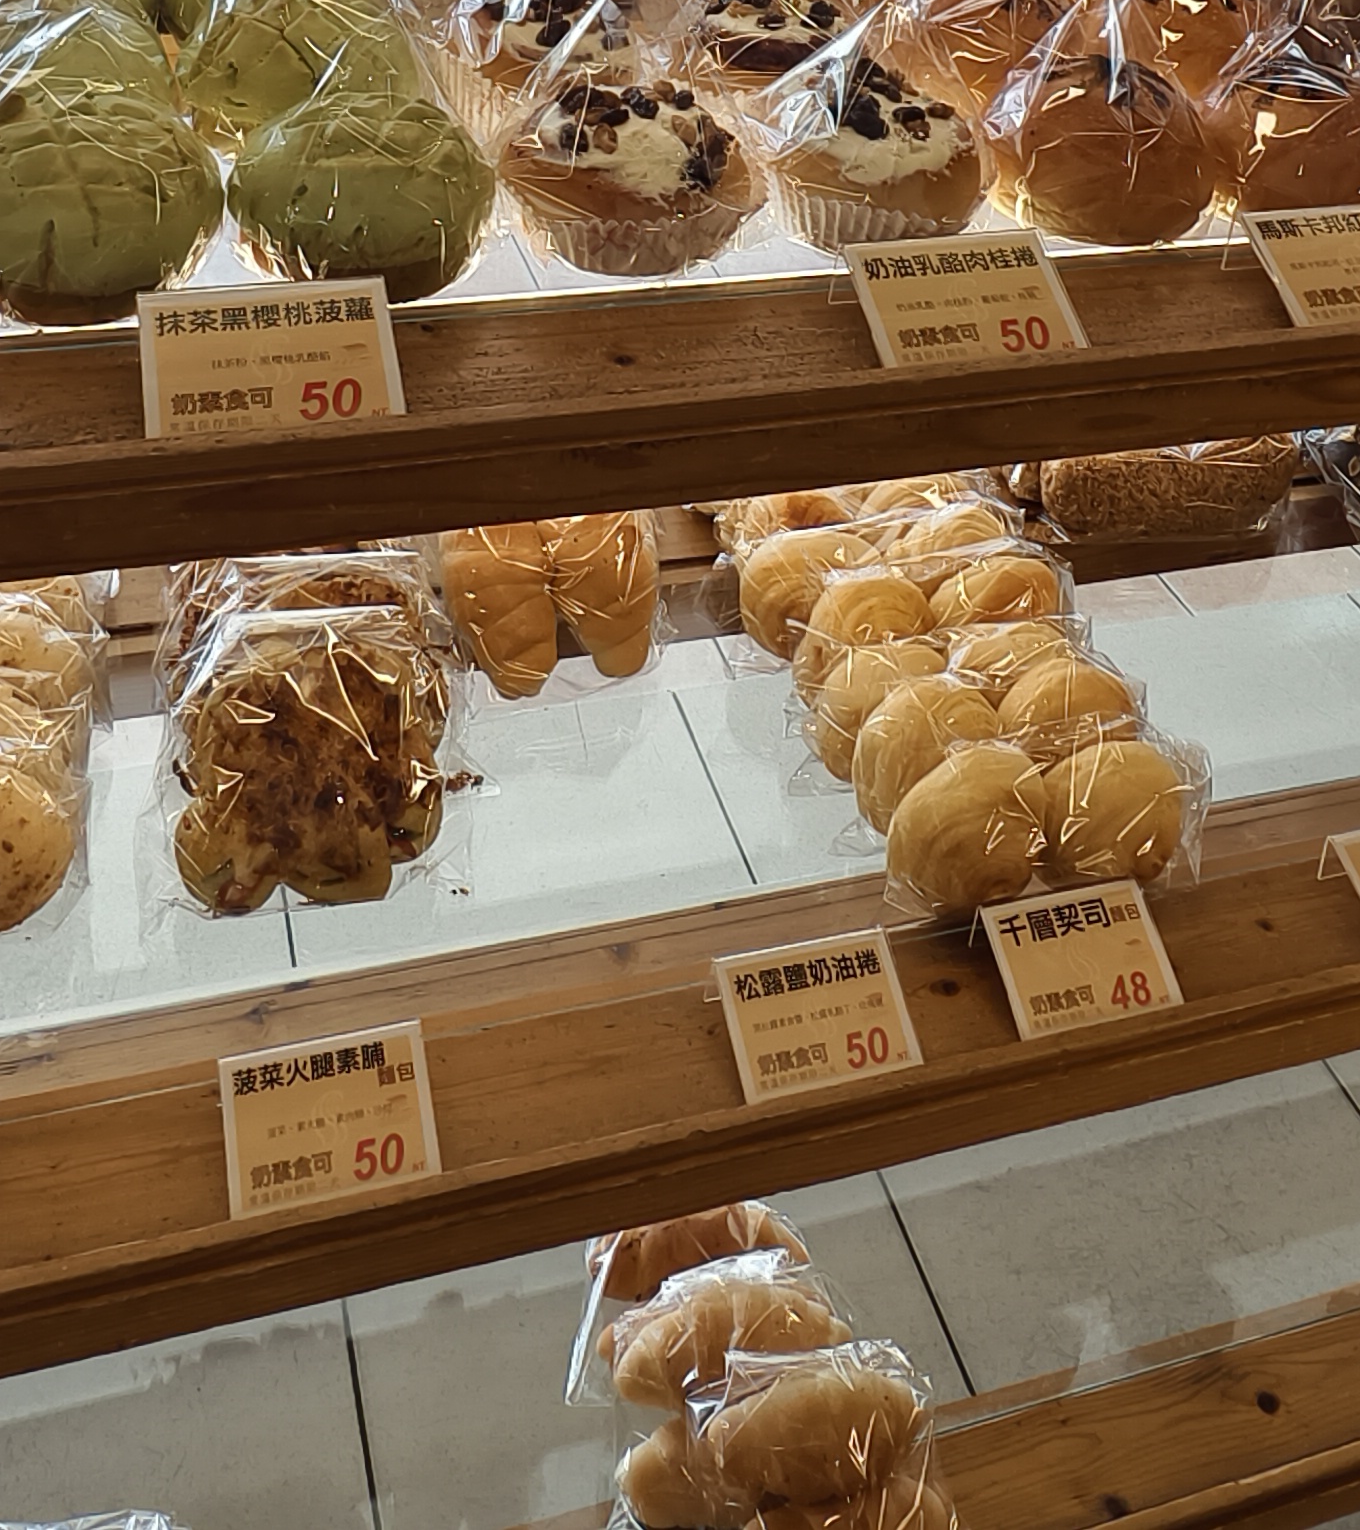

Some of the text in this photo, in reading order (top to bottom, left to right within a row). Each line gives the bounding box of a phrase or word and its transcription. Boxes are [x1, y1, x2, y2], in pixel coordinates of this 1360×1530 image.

[862, 245, 1039, 282] 奶油乳酪肉桂捲
[155, 296, 376, 337] 抹茶黑櫻桃菠蘿
[1000, 316, 1050, 353] 50
[299, 377, 362, 421] 50
[734, 948, 882, 1004] 松露鹽奶油捲
[1111, 971, 1152, 1009] 48
[846, 1026, 889, 1070] 50
[353, 1133, 405, 1181] 50
